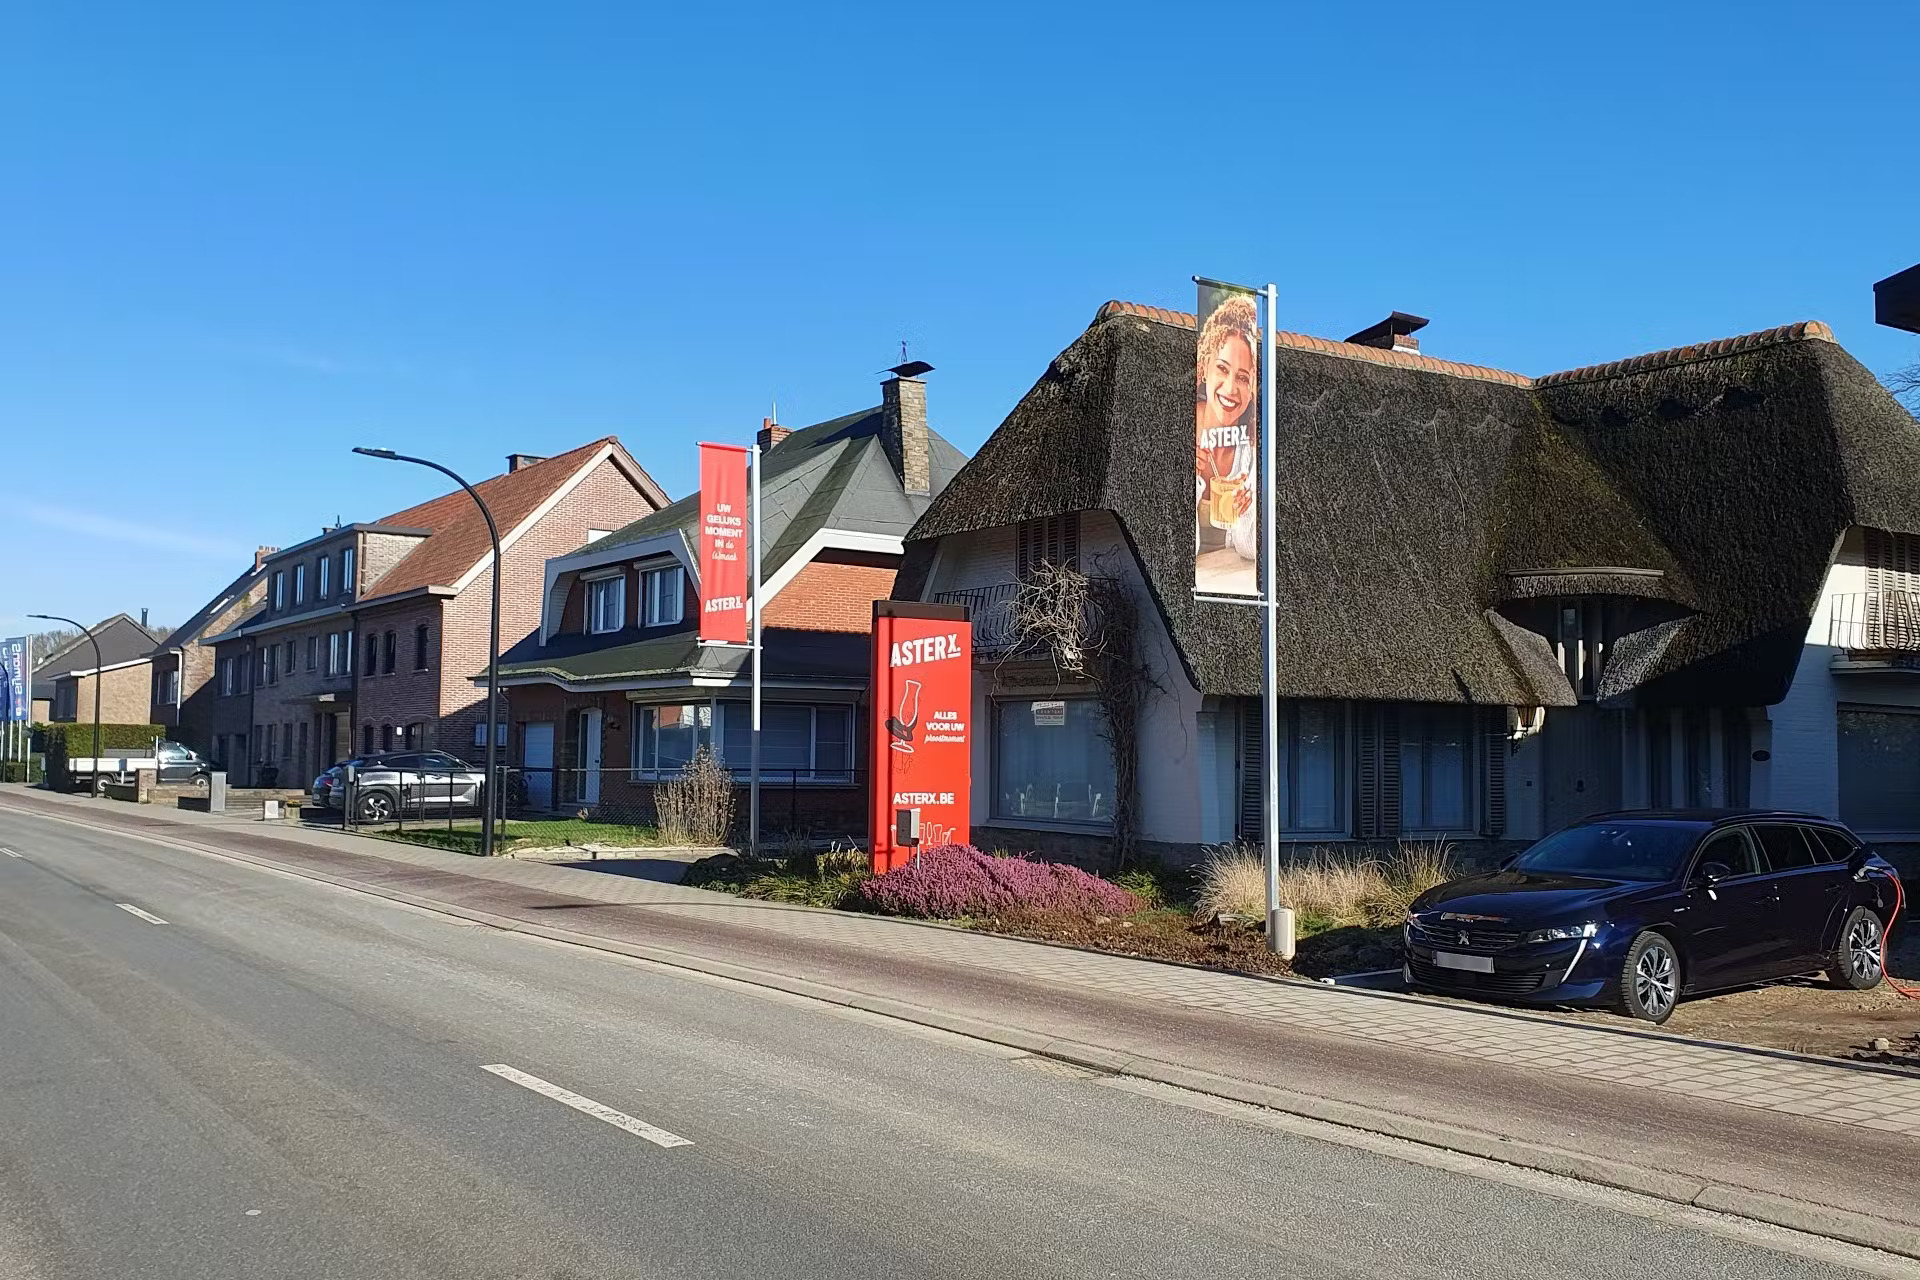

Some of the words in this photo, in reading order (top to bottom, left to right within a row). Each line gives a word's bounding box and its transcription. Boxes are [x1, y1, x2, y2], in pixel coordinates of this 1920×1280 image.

[716, 503, 732, 513] UW
[705, 525, 743, 538] MOMENT
[714, 539, 724, 548] IN
[933, 711, 958, 720] ALLES
[925, 722, 950, 731] VOOR
[950, 722, 965, 731] UW
[892, 791, 955, 806] ASTERX.BE
